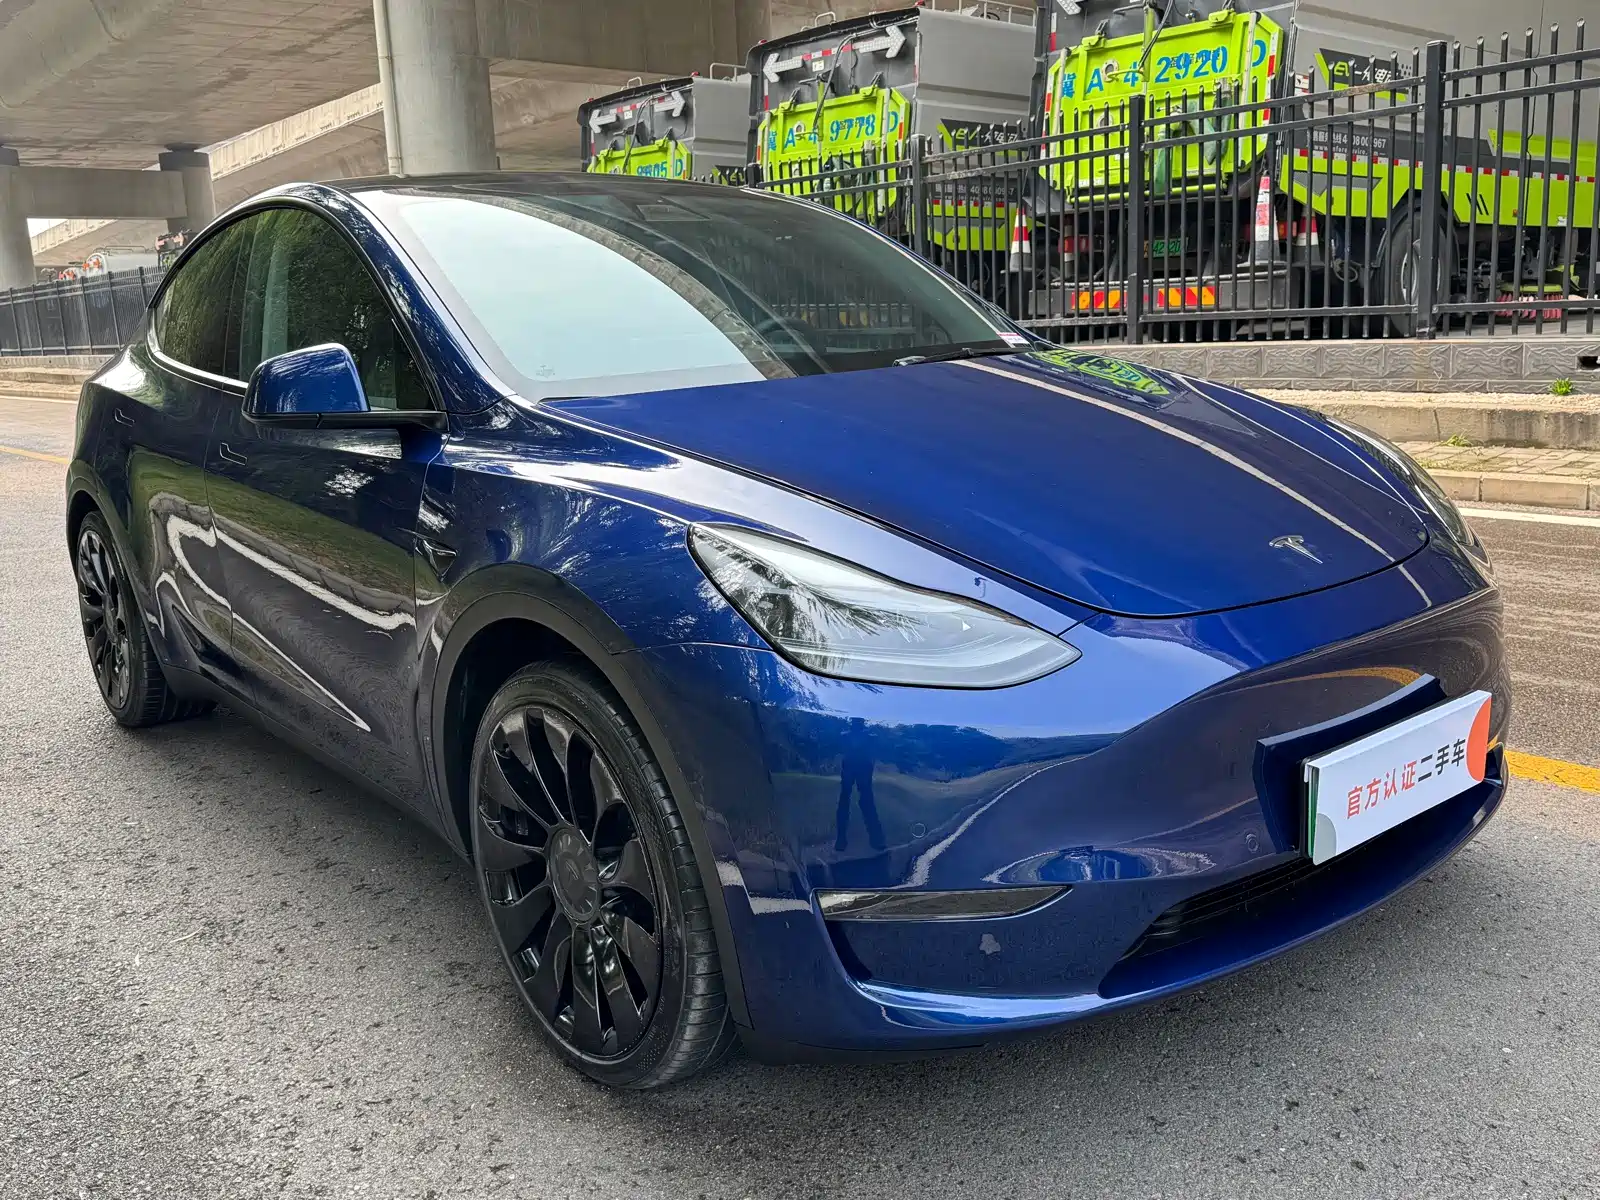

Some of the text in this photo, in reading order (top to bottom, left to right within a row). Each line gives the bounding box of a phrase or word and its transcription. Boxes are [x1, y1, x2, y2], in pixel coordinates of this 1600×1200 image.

[1347, 738, 1466, 819] 官方认证二手车
